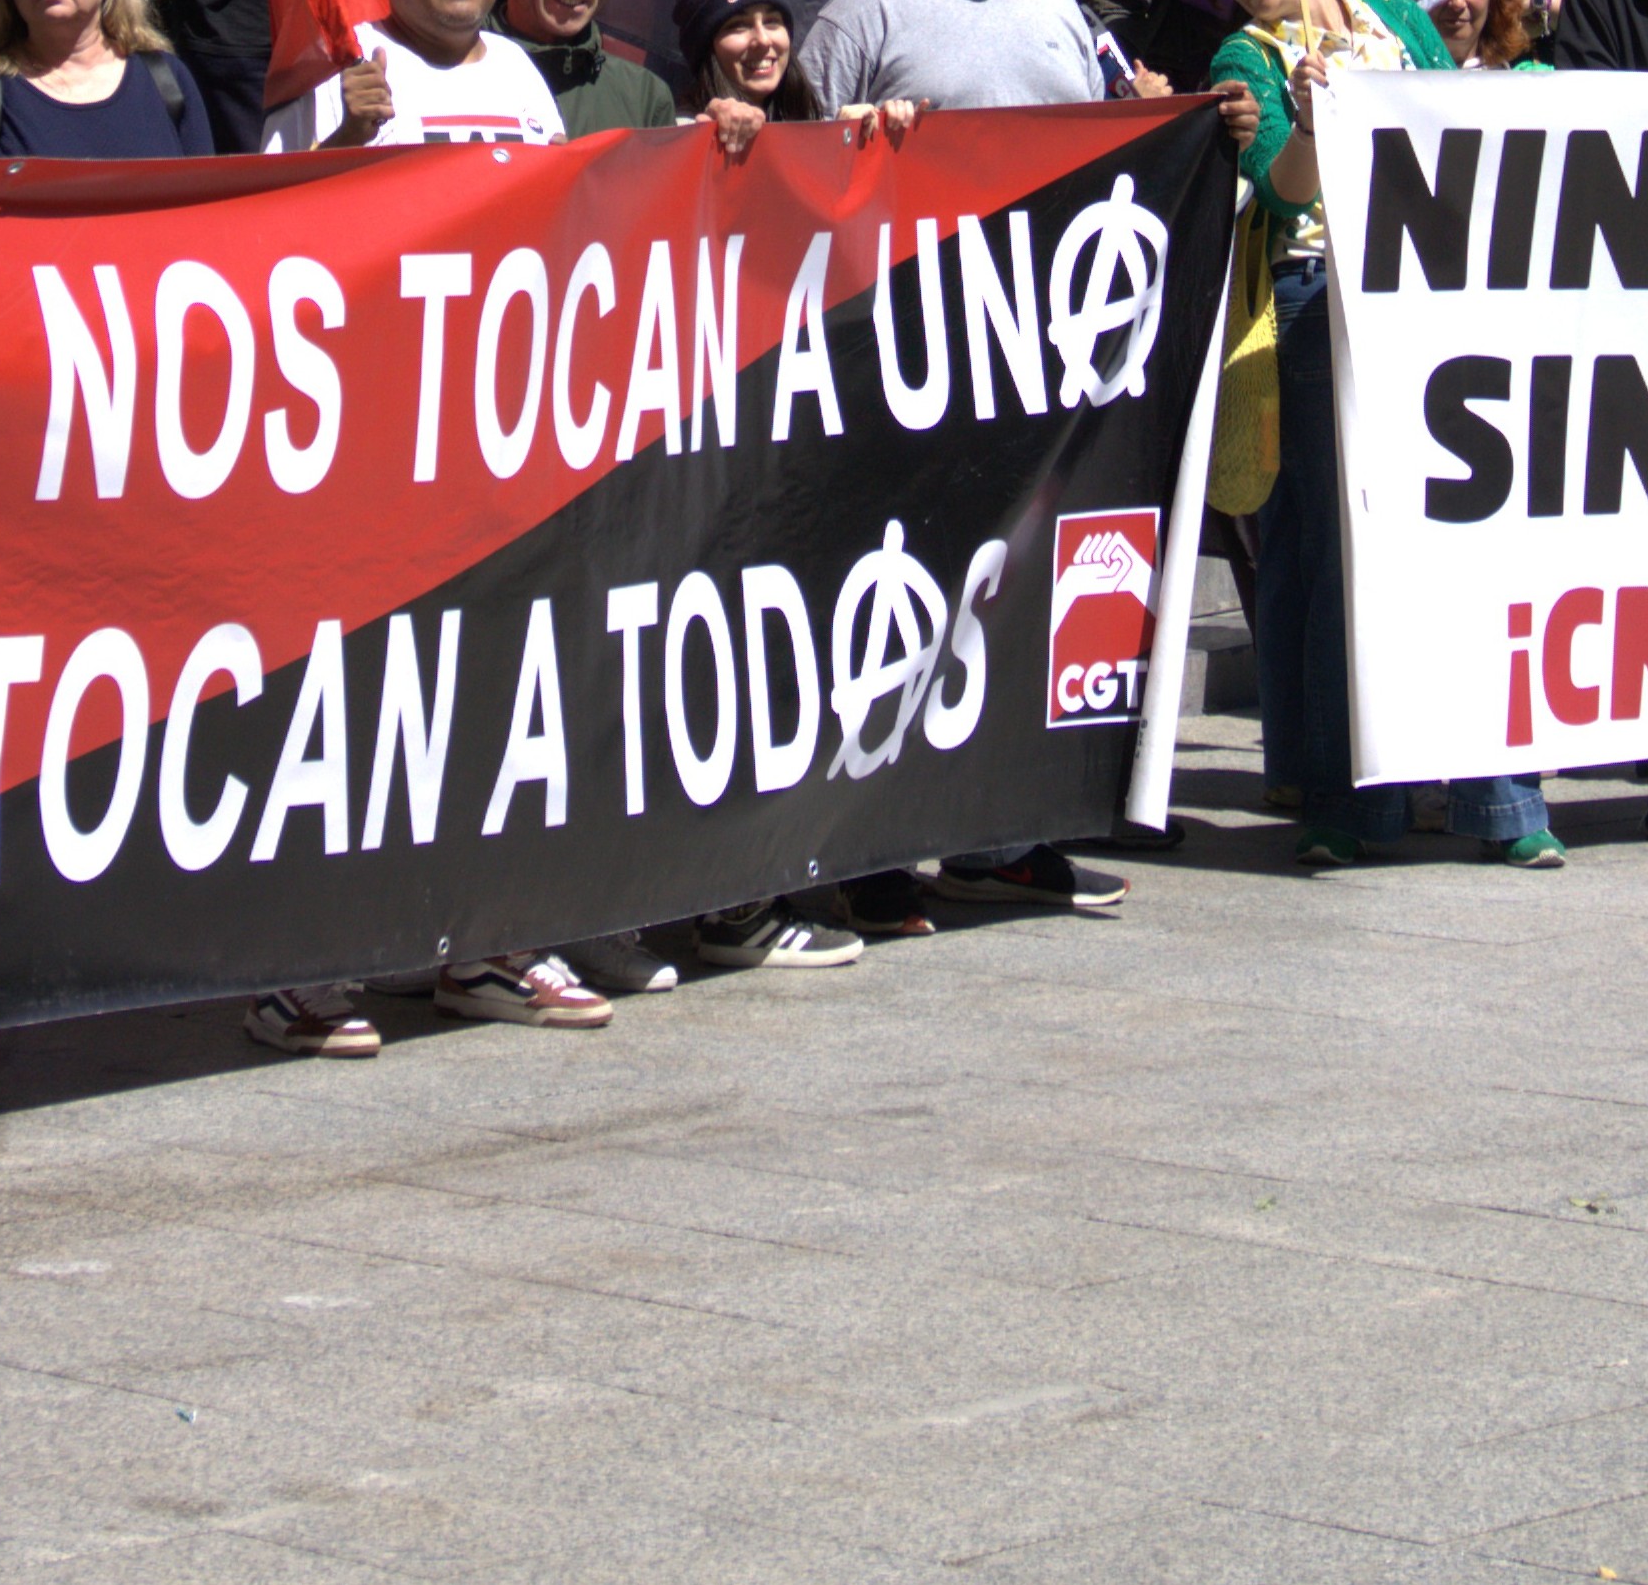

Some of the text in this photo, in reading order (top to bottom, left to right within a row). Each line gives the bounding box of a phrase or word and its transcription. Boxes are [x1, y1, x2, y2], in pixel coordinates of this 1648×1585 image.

[31, 255, 346, 500] NOS
[399, 235, 744, 483] TOCAN
[771, 231, 844, 442] A
[481, 597, 568, 836] A
[1057, 661, 1149, 713] CGT
